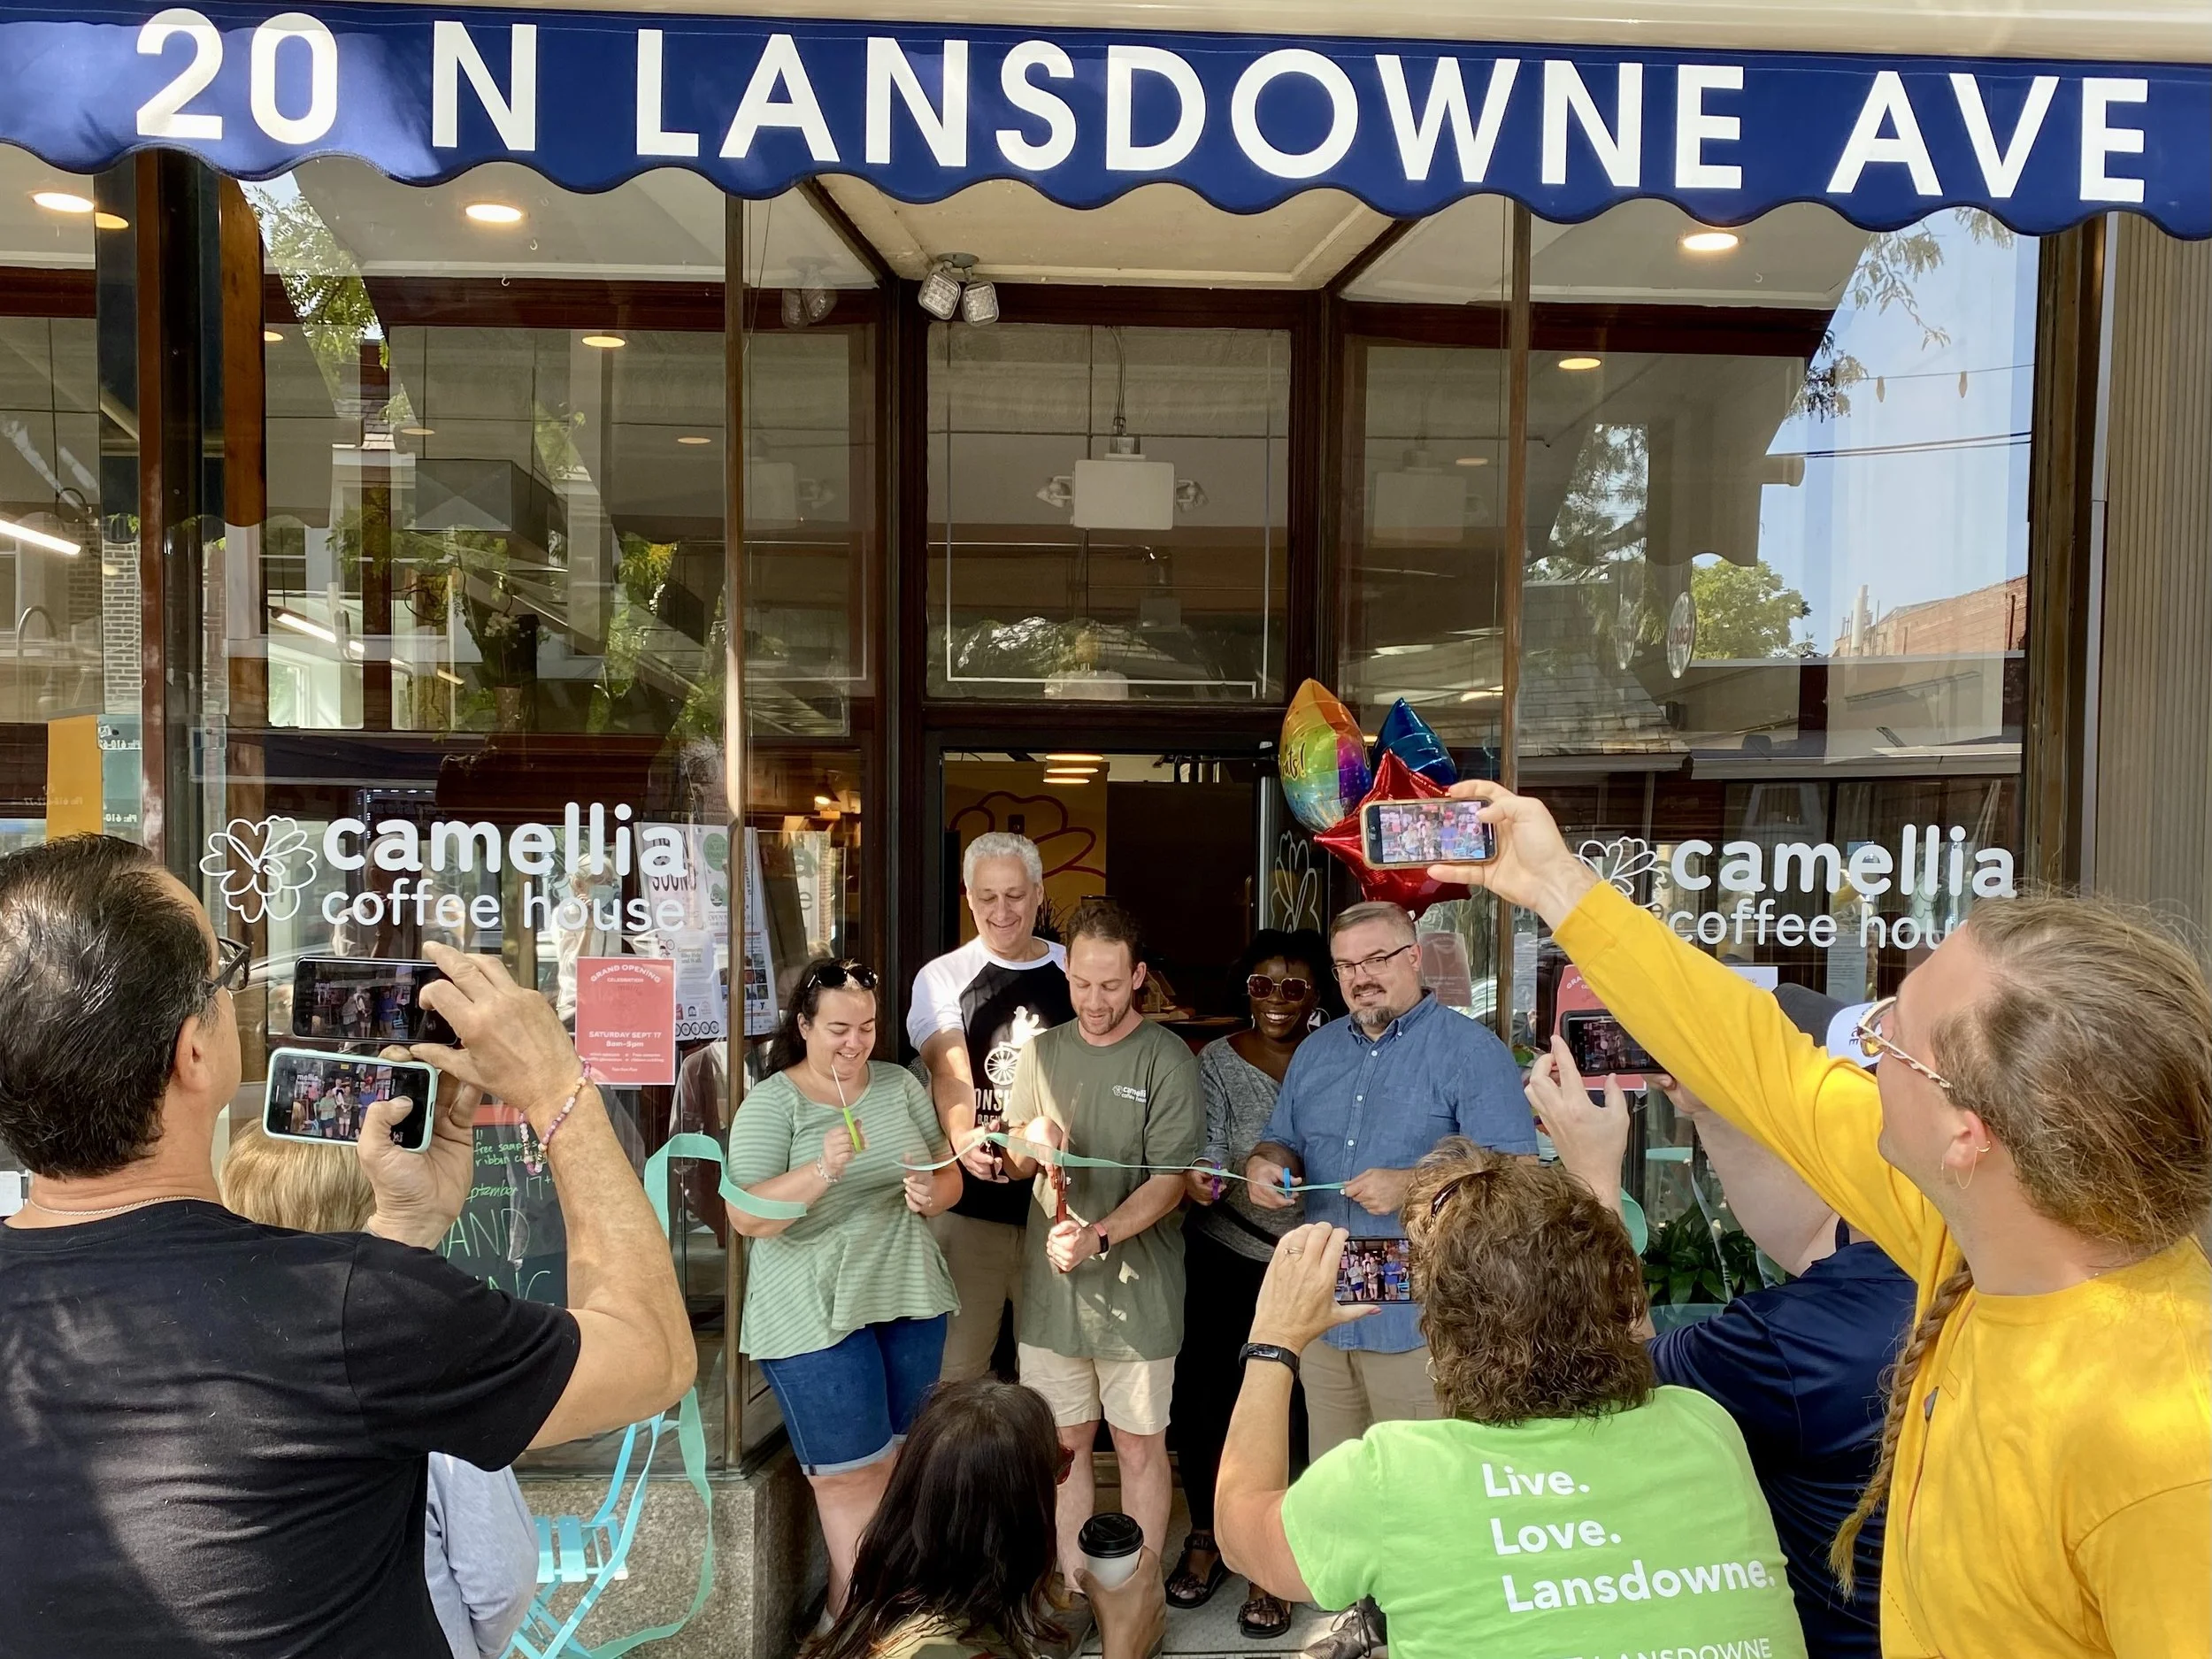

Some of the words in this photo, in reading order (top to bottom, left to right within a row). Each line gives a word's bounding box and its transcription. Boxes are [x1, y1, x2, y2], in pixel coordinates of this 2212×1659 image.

[135, 8, 339, 145] 20
[433, 20, 537, 151] N
[636, 28, 1744, 190] LANSDOWNE
[1825, 70, 2149, 204] AVE
[322, 803, 688, 876] camellia
[1671, 824, 2017, 898] camellia
[322, 878, 499, 927] coffee
[525, 881, 685, 932] house
[1669, 898, 1837, 948] coffee
[1860, 902, 1968, 950] hou
[590, 965, 620, 982] GRAND
[621, 964, 662, 983] OPENING
[1566, 976, 1586, 990] GRA
[1123, 1087, 1147, 1098] camelli
[465, 1179, 518, 1203] ptember
[1481, 1463, 1590, 1498] Live.
[1490, 1517, 1621, 1555] Love.
[1502, 1559, 1775, 1613] Lansdowne.
